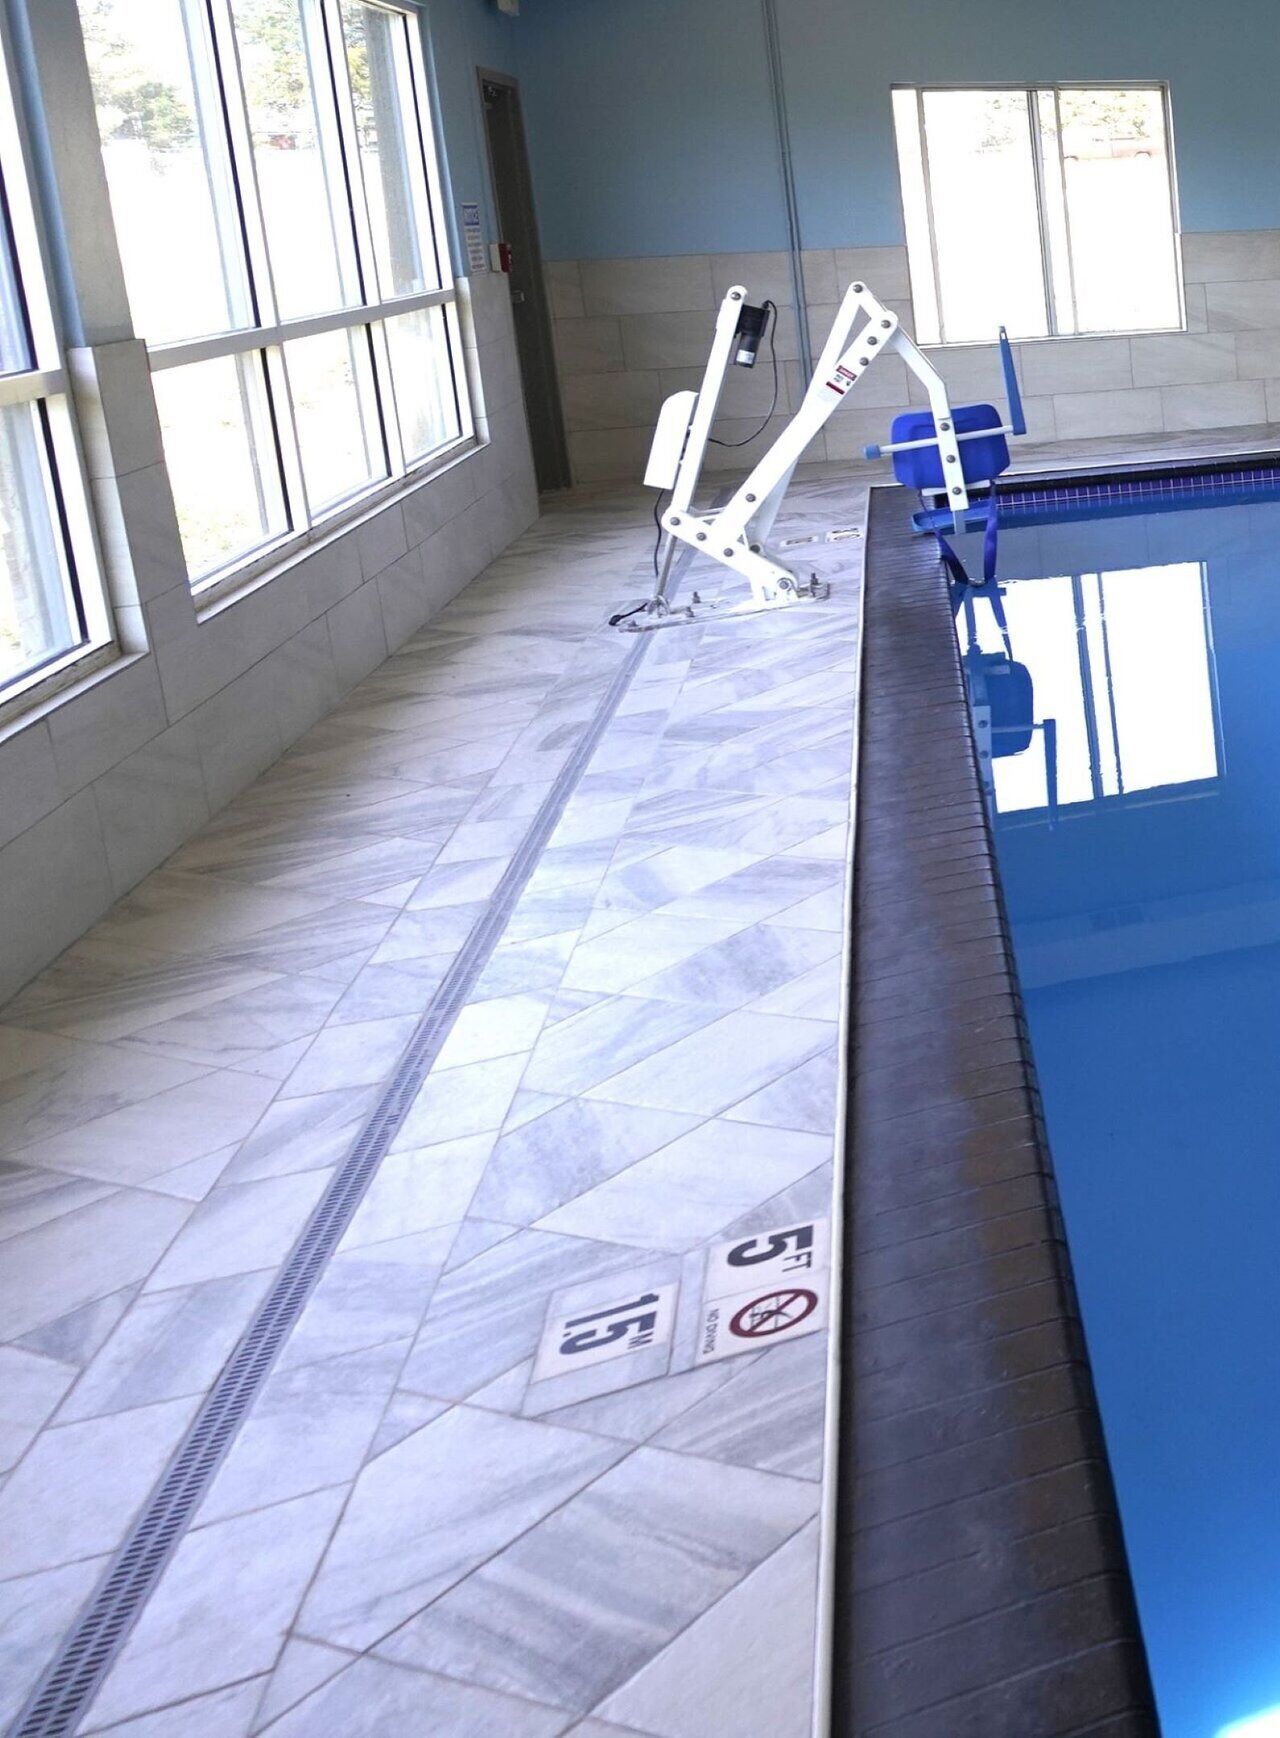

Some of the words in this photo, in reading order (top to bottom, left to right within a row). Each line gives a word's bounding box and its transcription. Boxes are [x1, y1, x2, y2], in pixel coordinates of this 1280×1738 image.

[727, 1224, 815, 1268] 5
[781, 1250, 813, 1273] FT
[559, 1293, 660, 1355] 1.5
[626, 1331, 655, 1350] M
[706, 1308, 720, 1323] NO
[702, 1322, 719, 1355] DIVING
